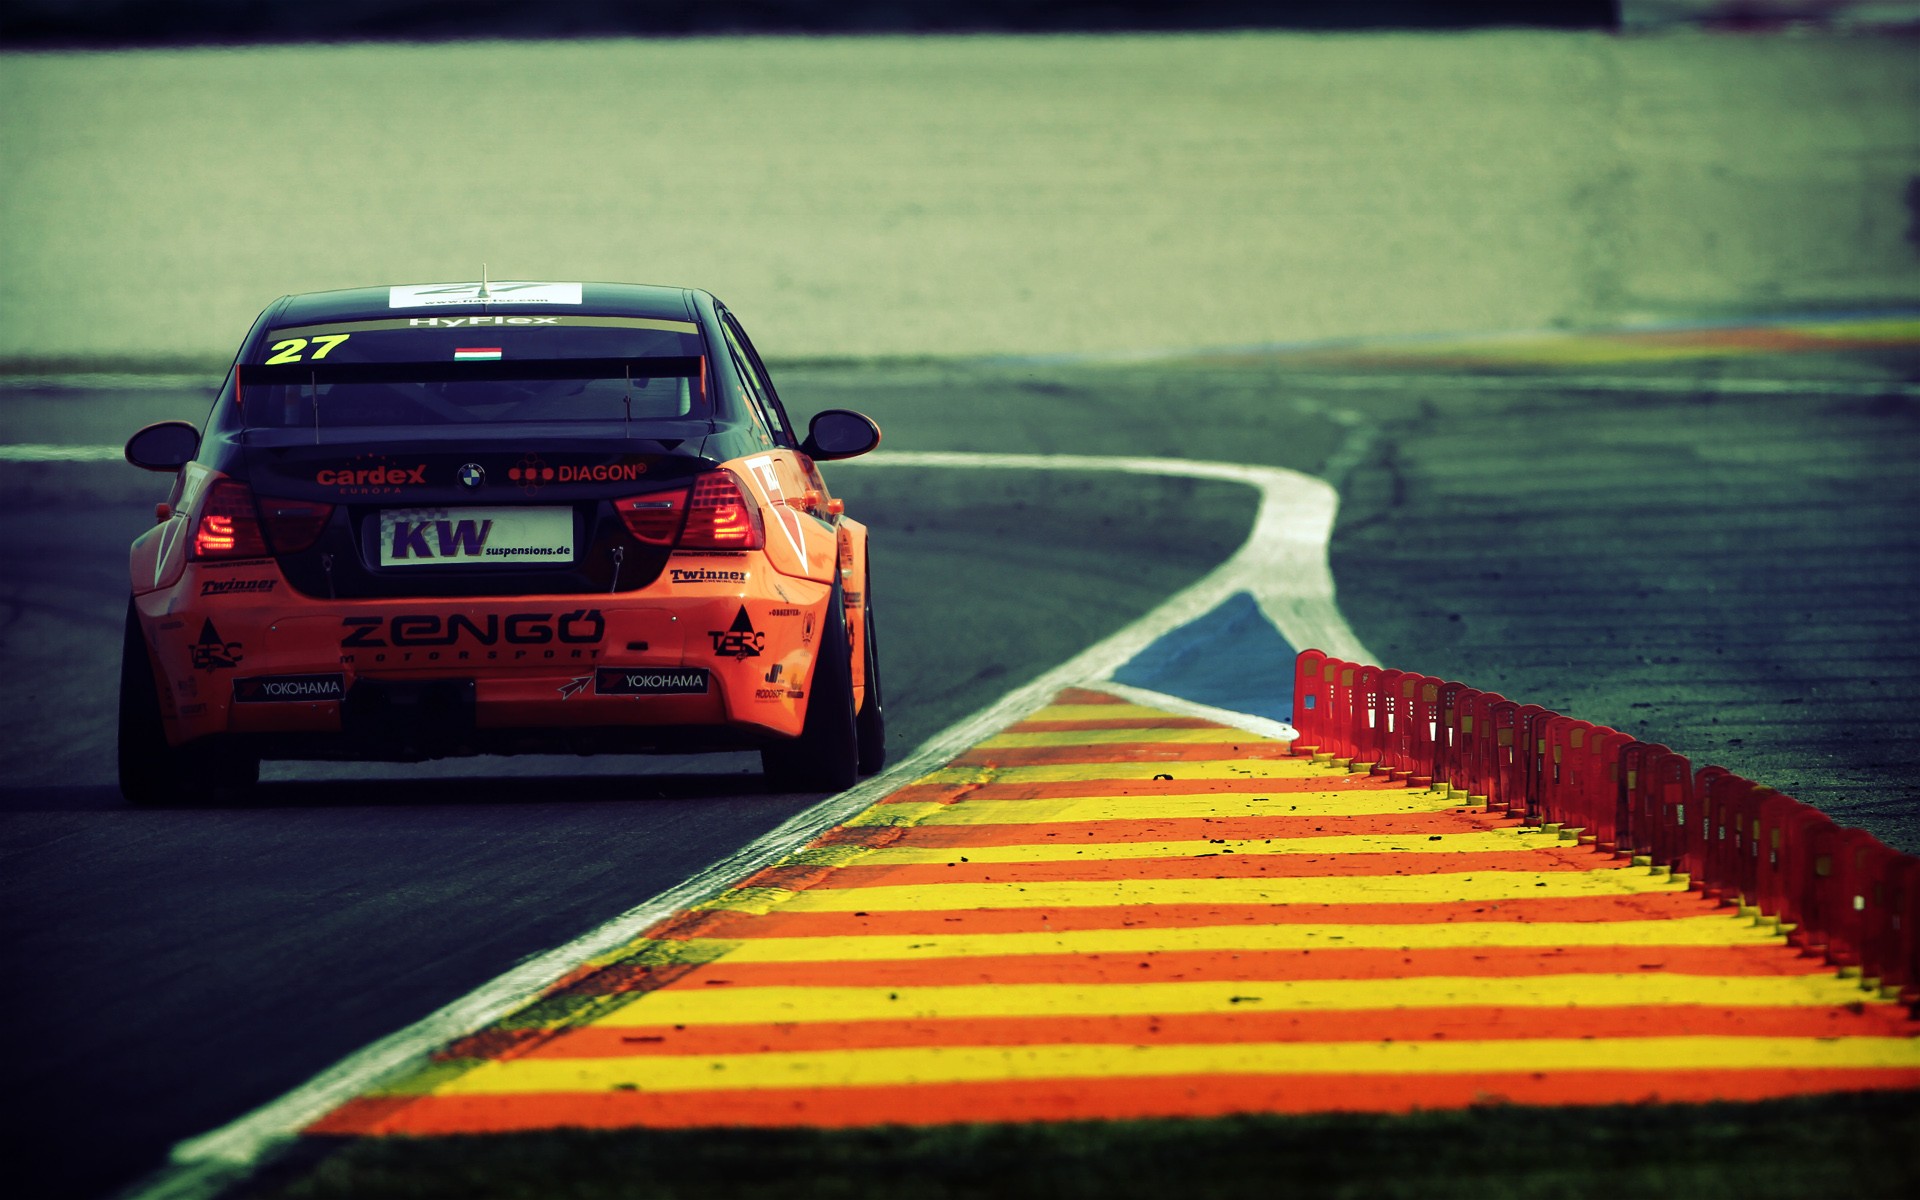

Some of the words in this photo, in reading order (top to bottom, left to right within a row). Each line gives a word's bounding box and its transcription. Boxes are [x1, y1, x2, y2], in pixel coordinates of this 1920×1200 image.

[409, 316, 558, 328] HyFlex
[265, 334, 350, 365] 27
[391, 519, 493, 559] KW
[486, 546, 571, 557] suspensions.de
[670, 567, 747, 581] Twinner
[202, 578, 278, 593] Twinner
[340, 649, 601, 665] MOTORSPORT
[263, 681, 340, 694] YOKOHAMA
[626, 675, 704, 687] YOKOHAMA
